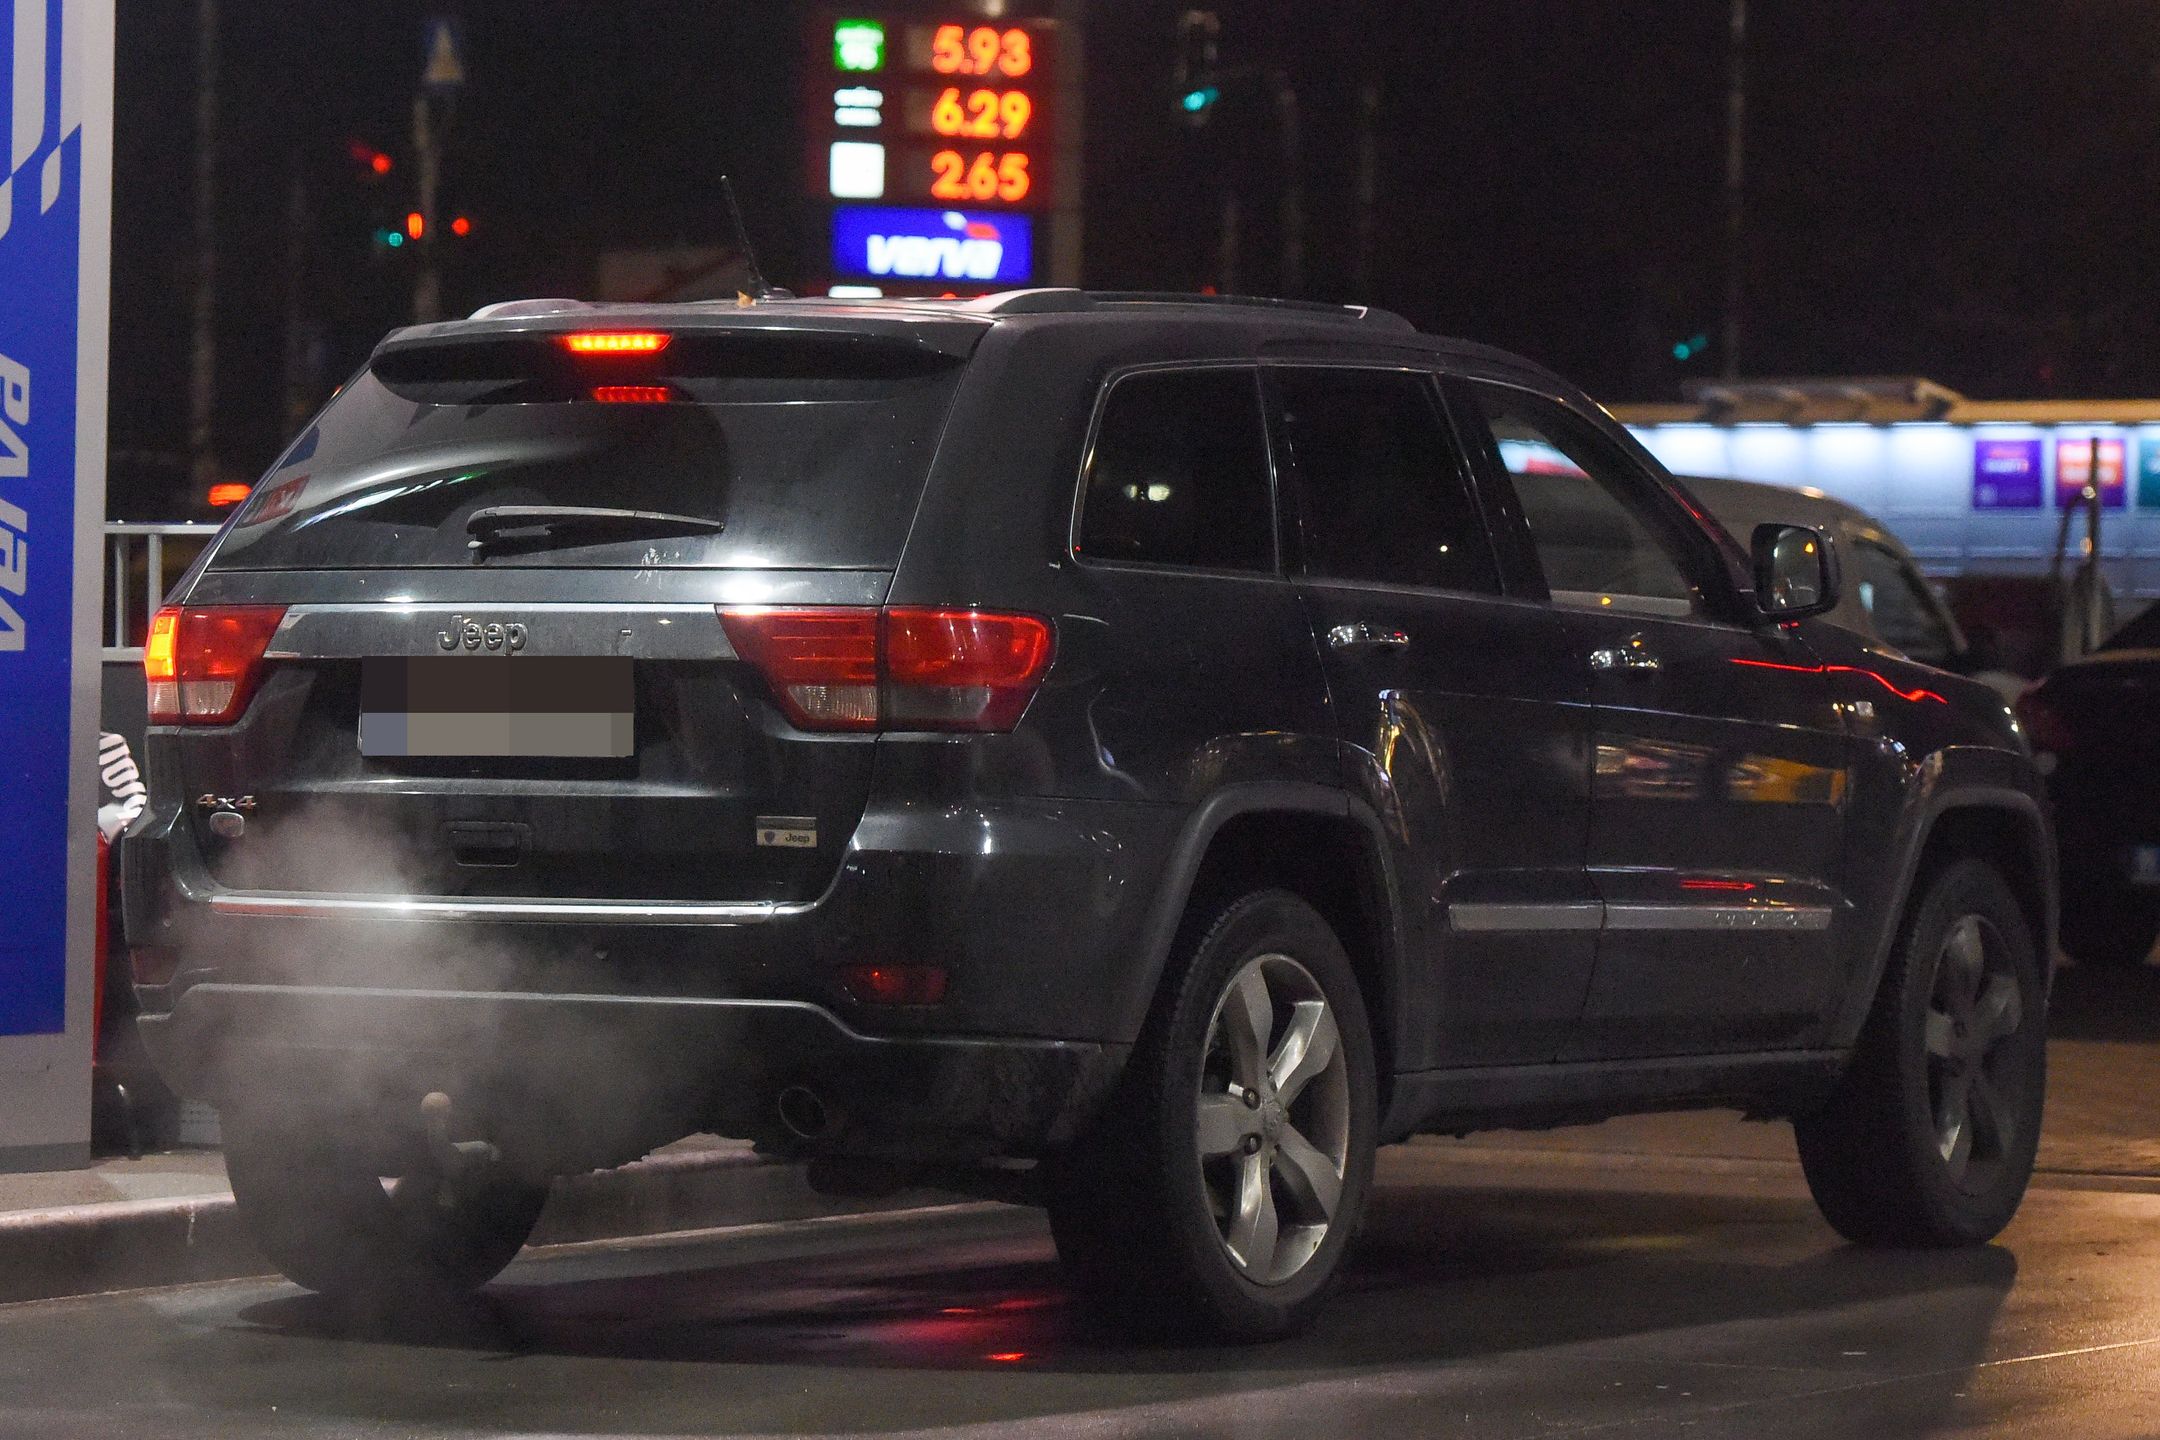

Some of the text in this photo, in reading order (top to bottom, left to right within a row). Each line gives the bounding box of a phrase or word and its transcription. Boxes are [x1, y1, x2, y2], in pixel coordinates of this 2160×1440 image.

[933, 25, 1031, 77] 5.93
[932, 88, 1031, 139] 6.29
[931, 151, 1030, 201] 2.65
[438, 614, 528, 656] Jeep
